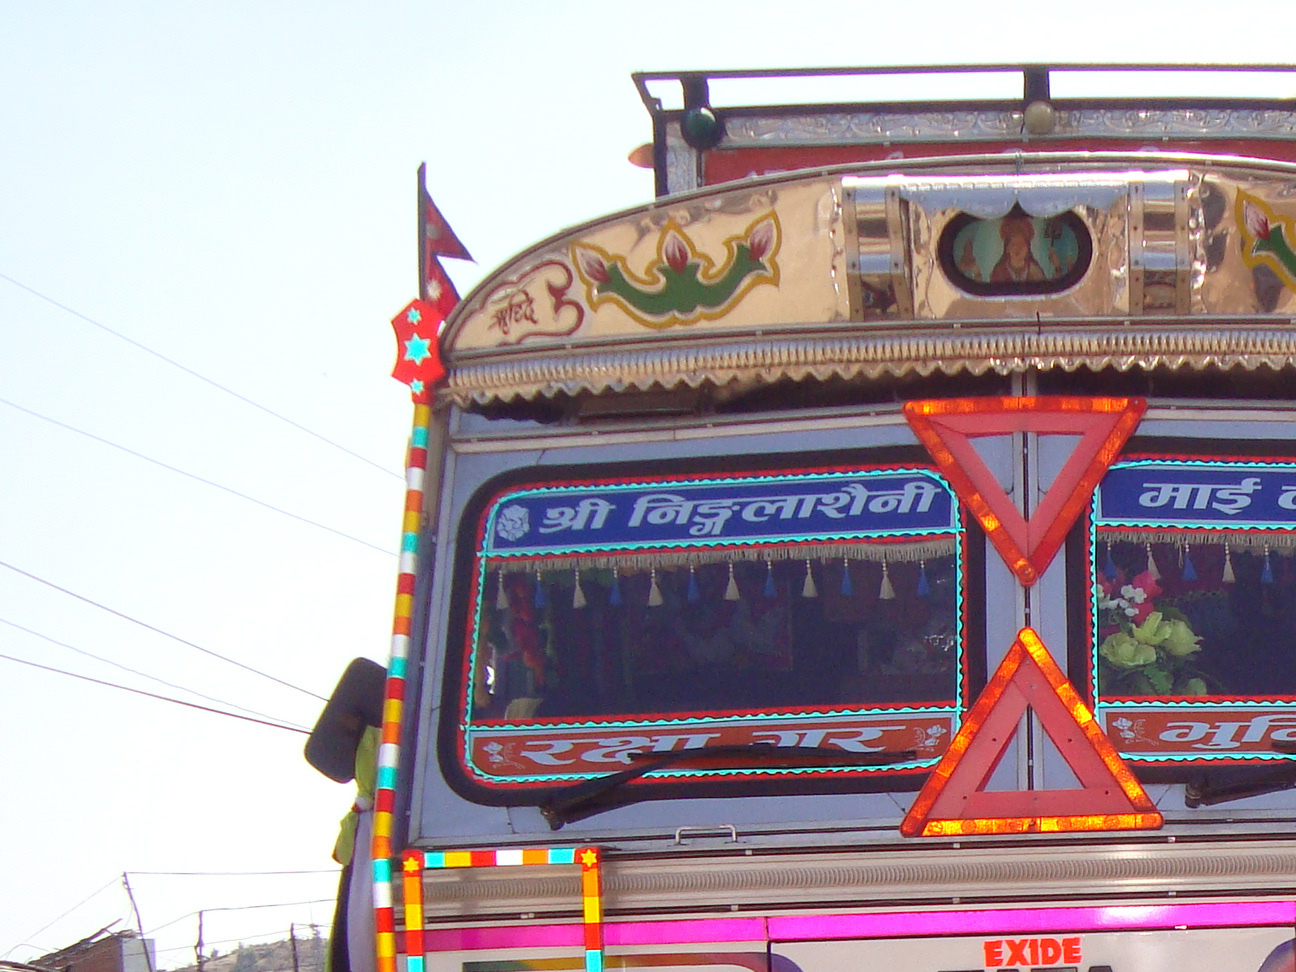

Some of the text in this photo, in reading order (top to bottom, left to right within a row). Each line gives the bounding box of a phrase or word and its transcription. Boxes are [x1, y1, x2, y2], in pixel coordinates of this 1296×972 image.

[1138, 477, 1262, 515] माई
[539, 498, 616, 534] श्री
[984, 937, 1082, 967] EXIDE
